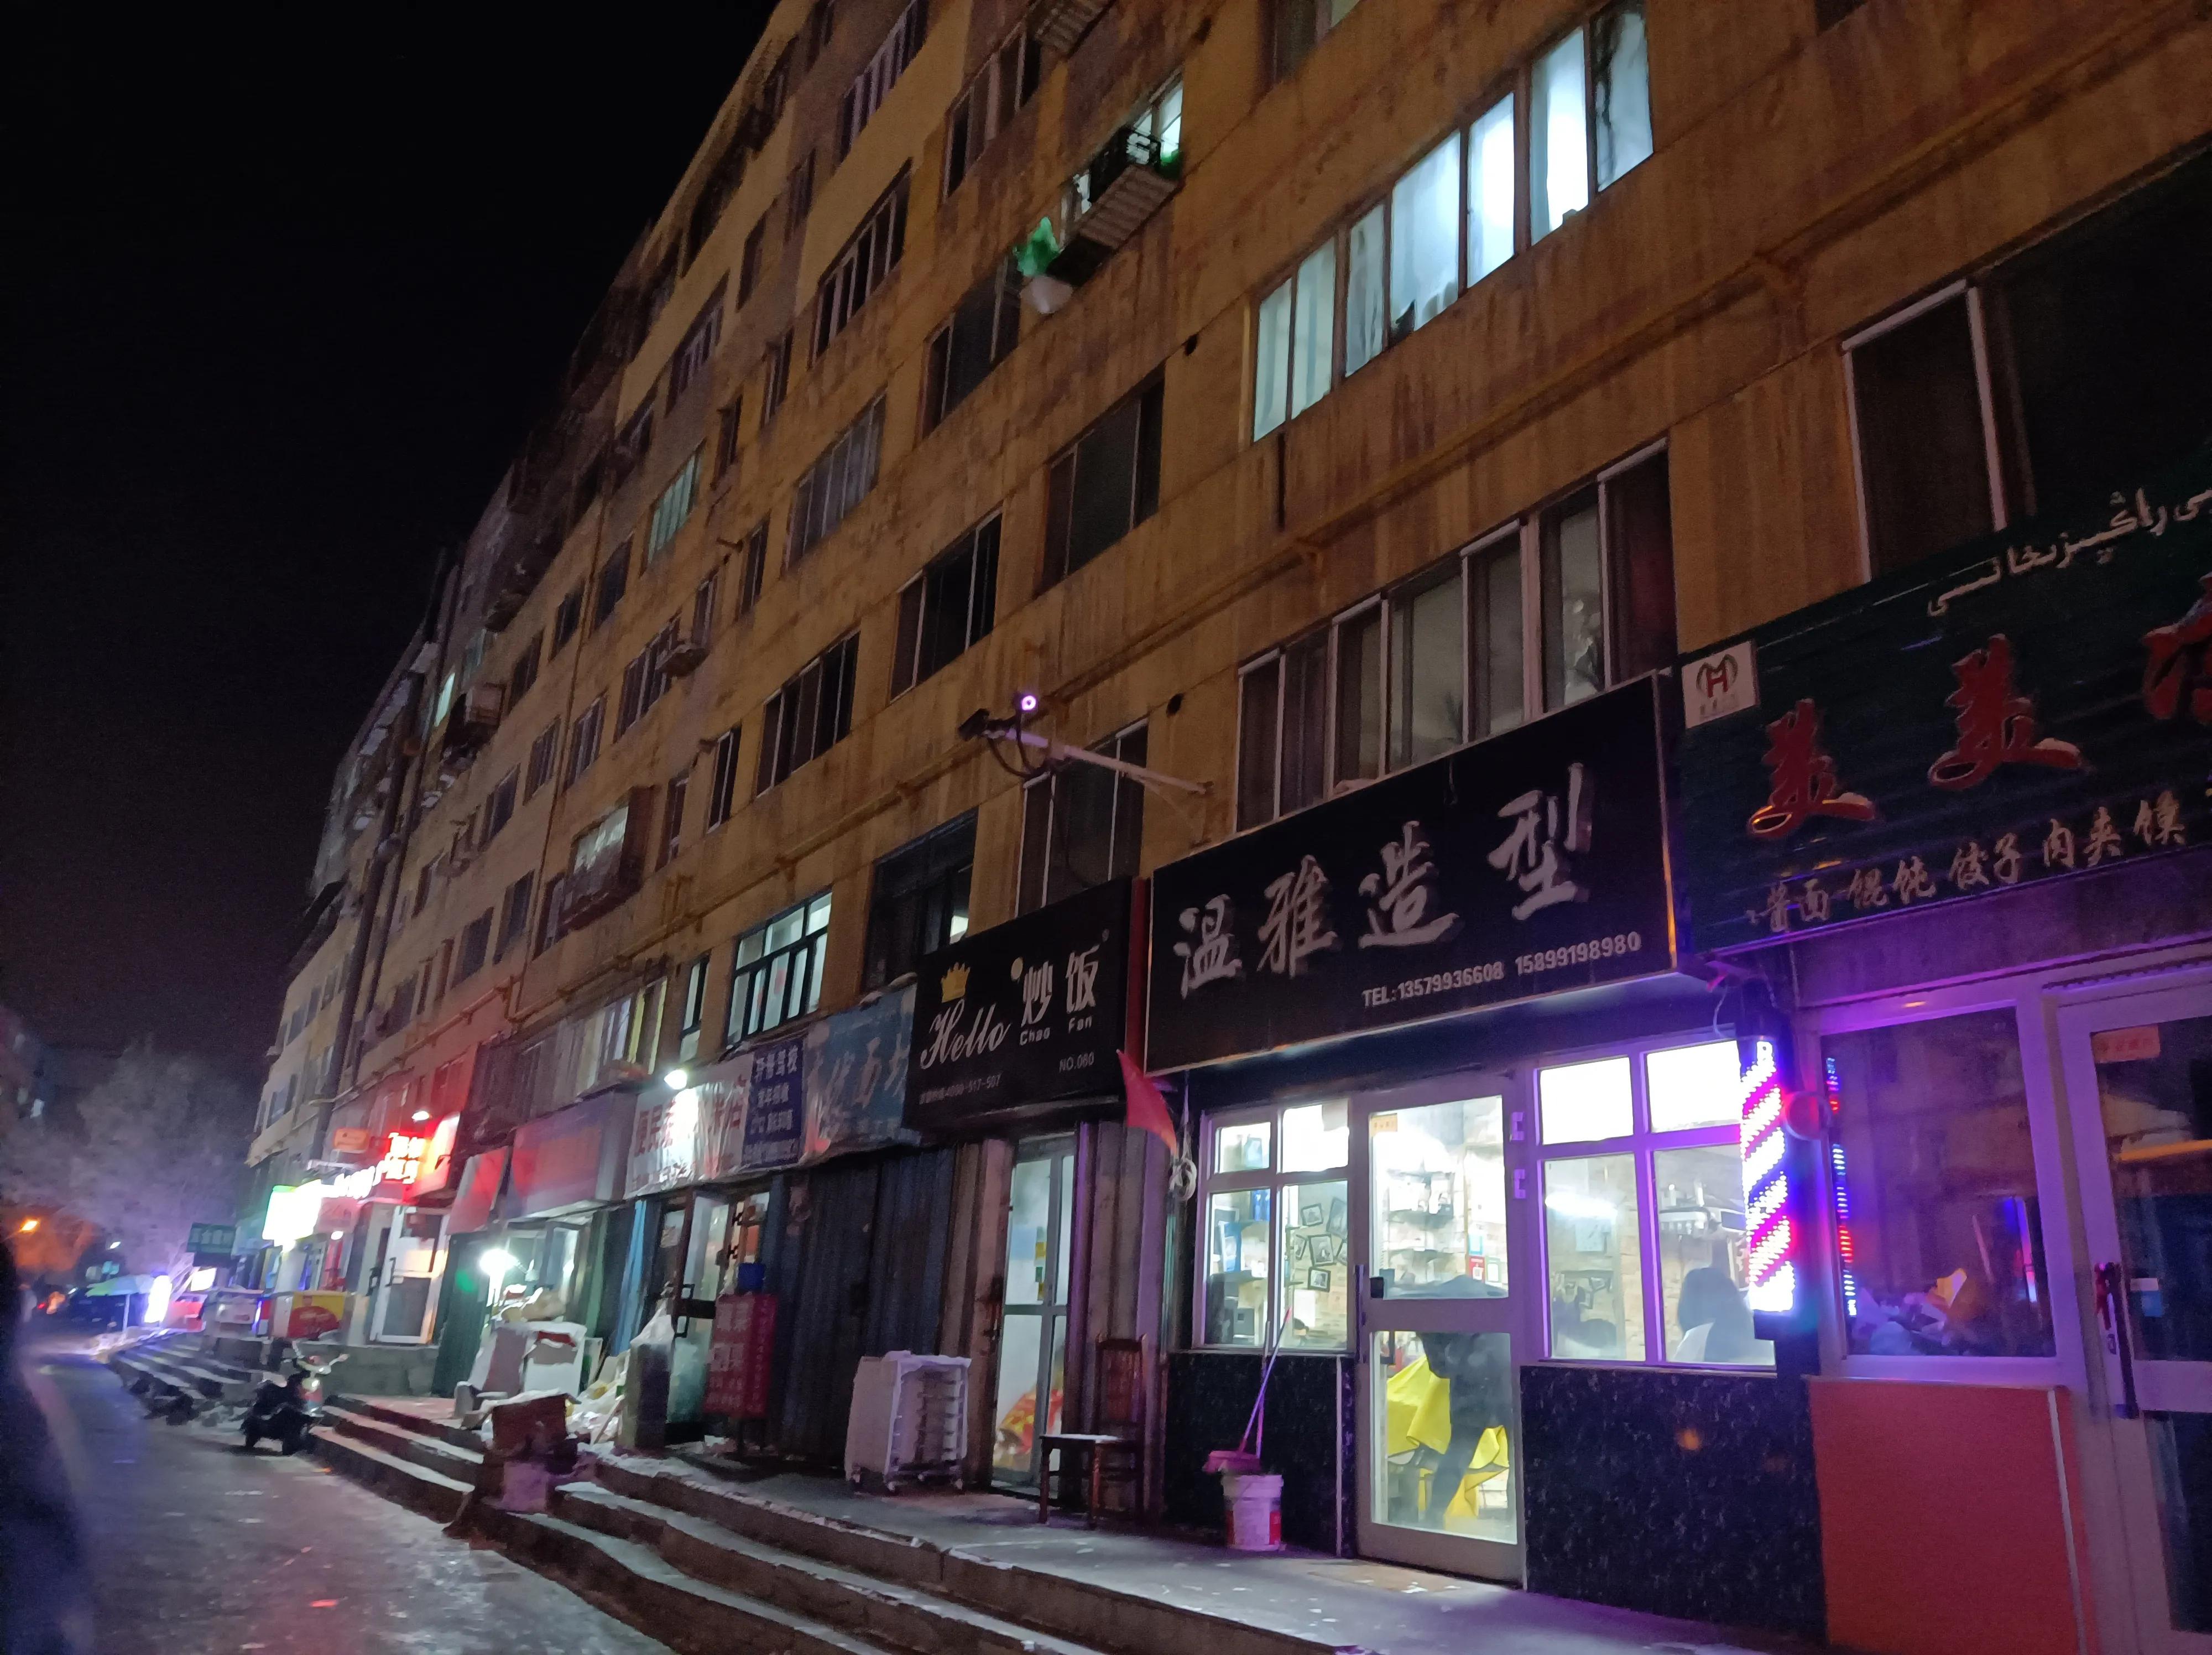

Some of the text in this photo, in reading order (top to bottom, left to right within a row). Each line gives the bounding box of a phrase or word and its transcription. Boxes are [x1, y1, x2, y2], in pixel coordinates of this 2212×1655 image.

[1172, 762, 1594, 1000] 温雅造型
[1948, 832, 2023, 891] 饺子
[1021, 945, 1100, 1028] 炒饭
[1361, 931, 1642, 1008] TEL:13579936608 15899198980
[920, 998, 1011, 1069] Hello
[1019, 1016, 1093, 1046] Chao Fan
